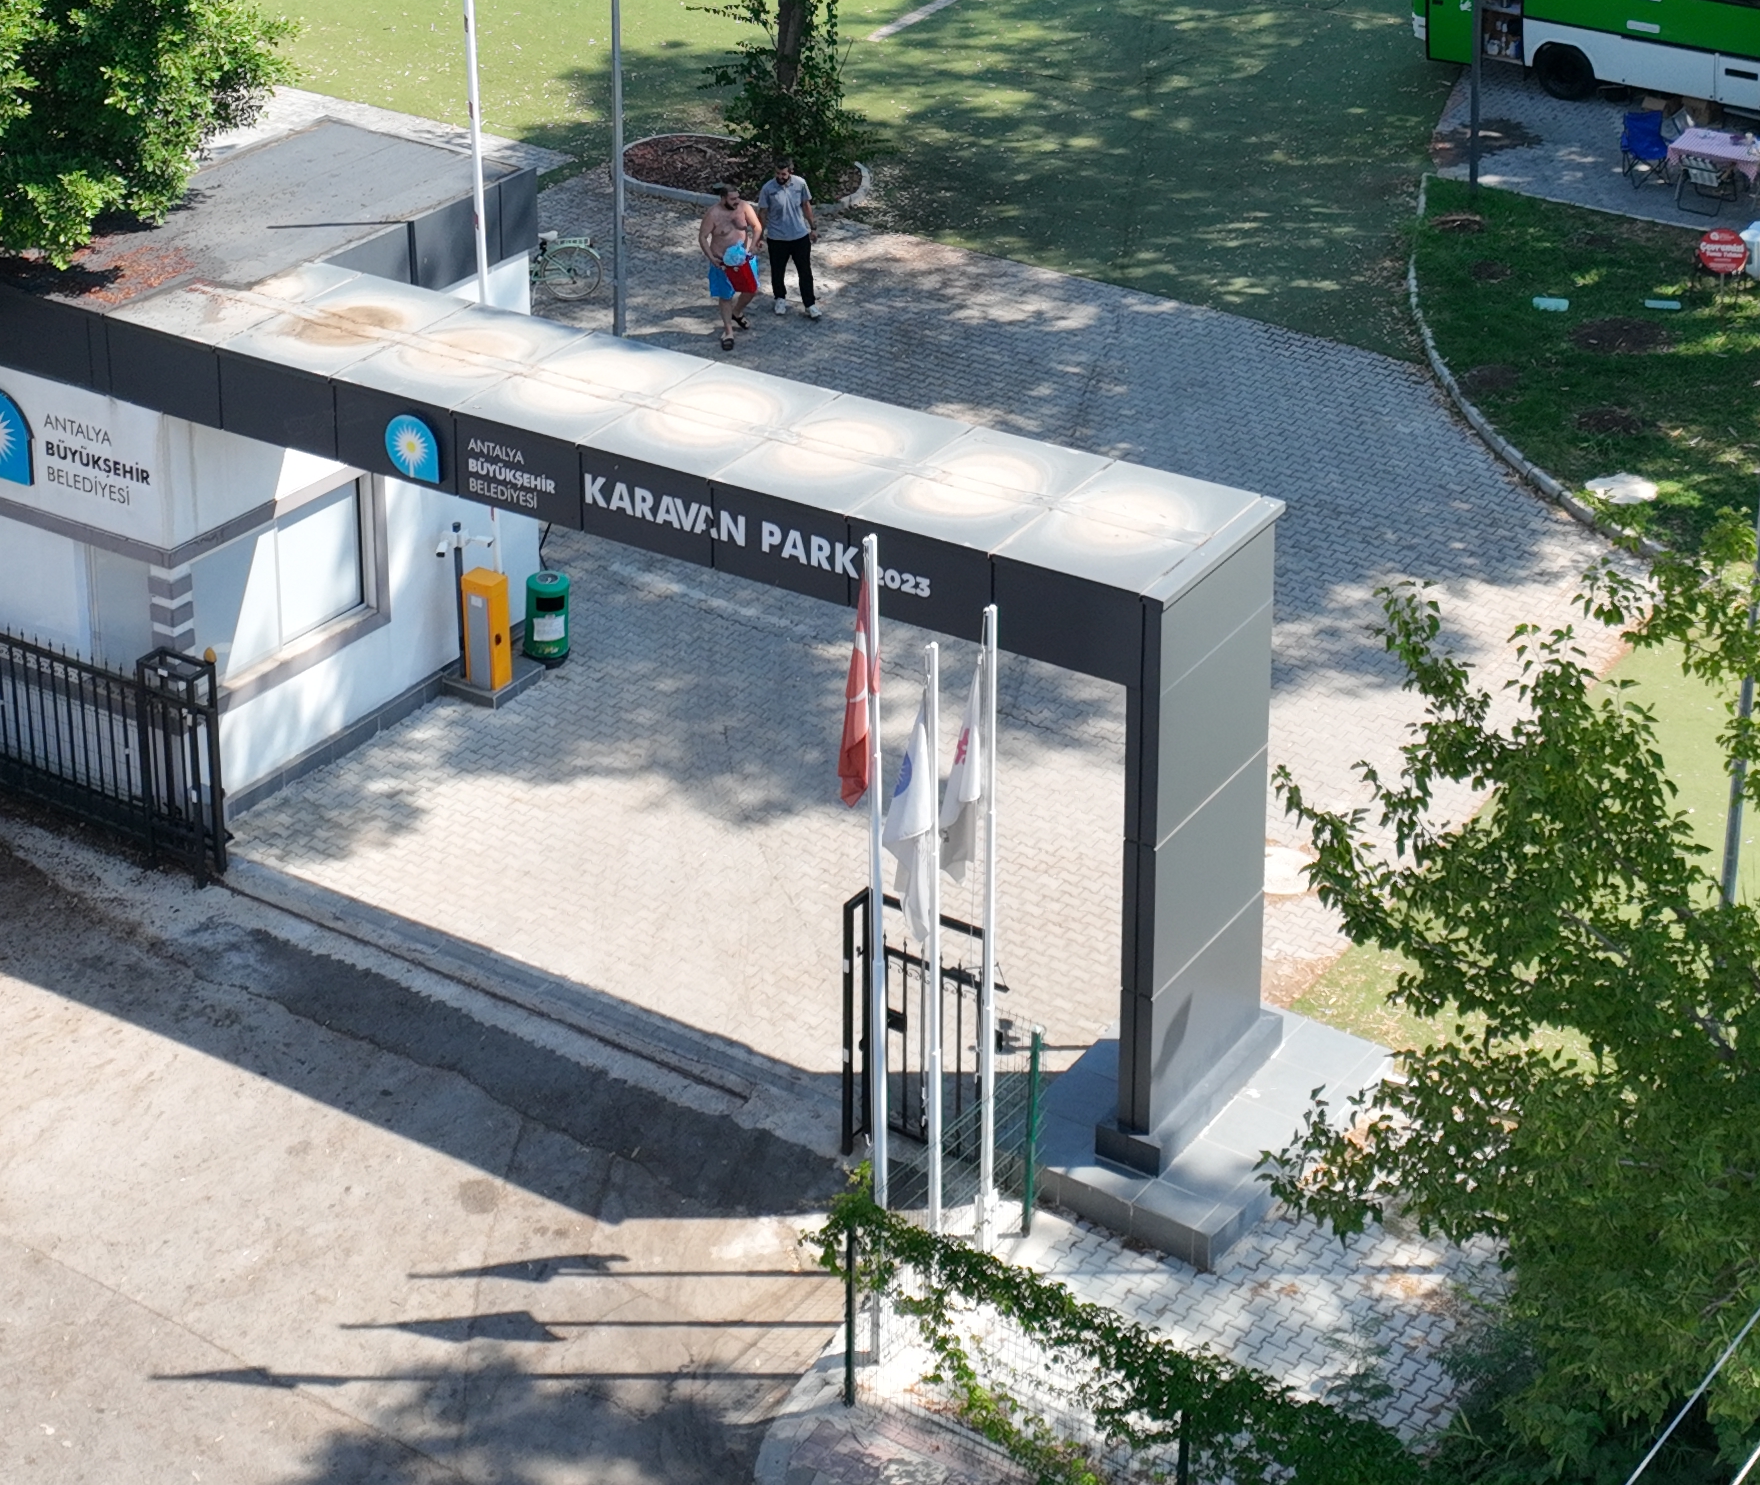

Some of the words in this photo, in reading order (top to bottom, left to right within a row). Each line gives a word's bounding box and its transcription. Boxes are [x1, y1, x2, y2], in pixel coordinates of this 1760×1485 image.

[44, 413, 112, 447] ANTALYA
[45, 439, 151, 486] BÜYÜKŞEHİR
[468, 438, 525, 465] ANTALYA
[47, 466, 130, 506] BELEDİYESİ
[468, 457, 555, 494] BÜYÜKŞEHİR
[469, 477, 537, 509] BELEDİYESİ
[584, 473, 746, 547] KARAVAN
[761, 521, 859, 579] PARK
